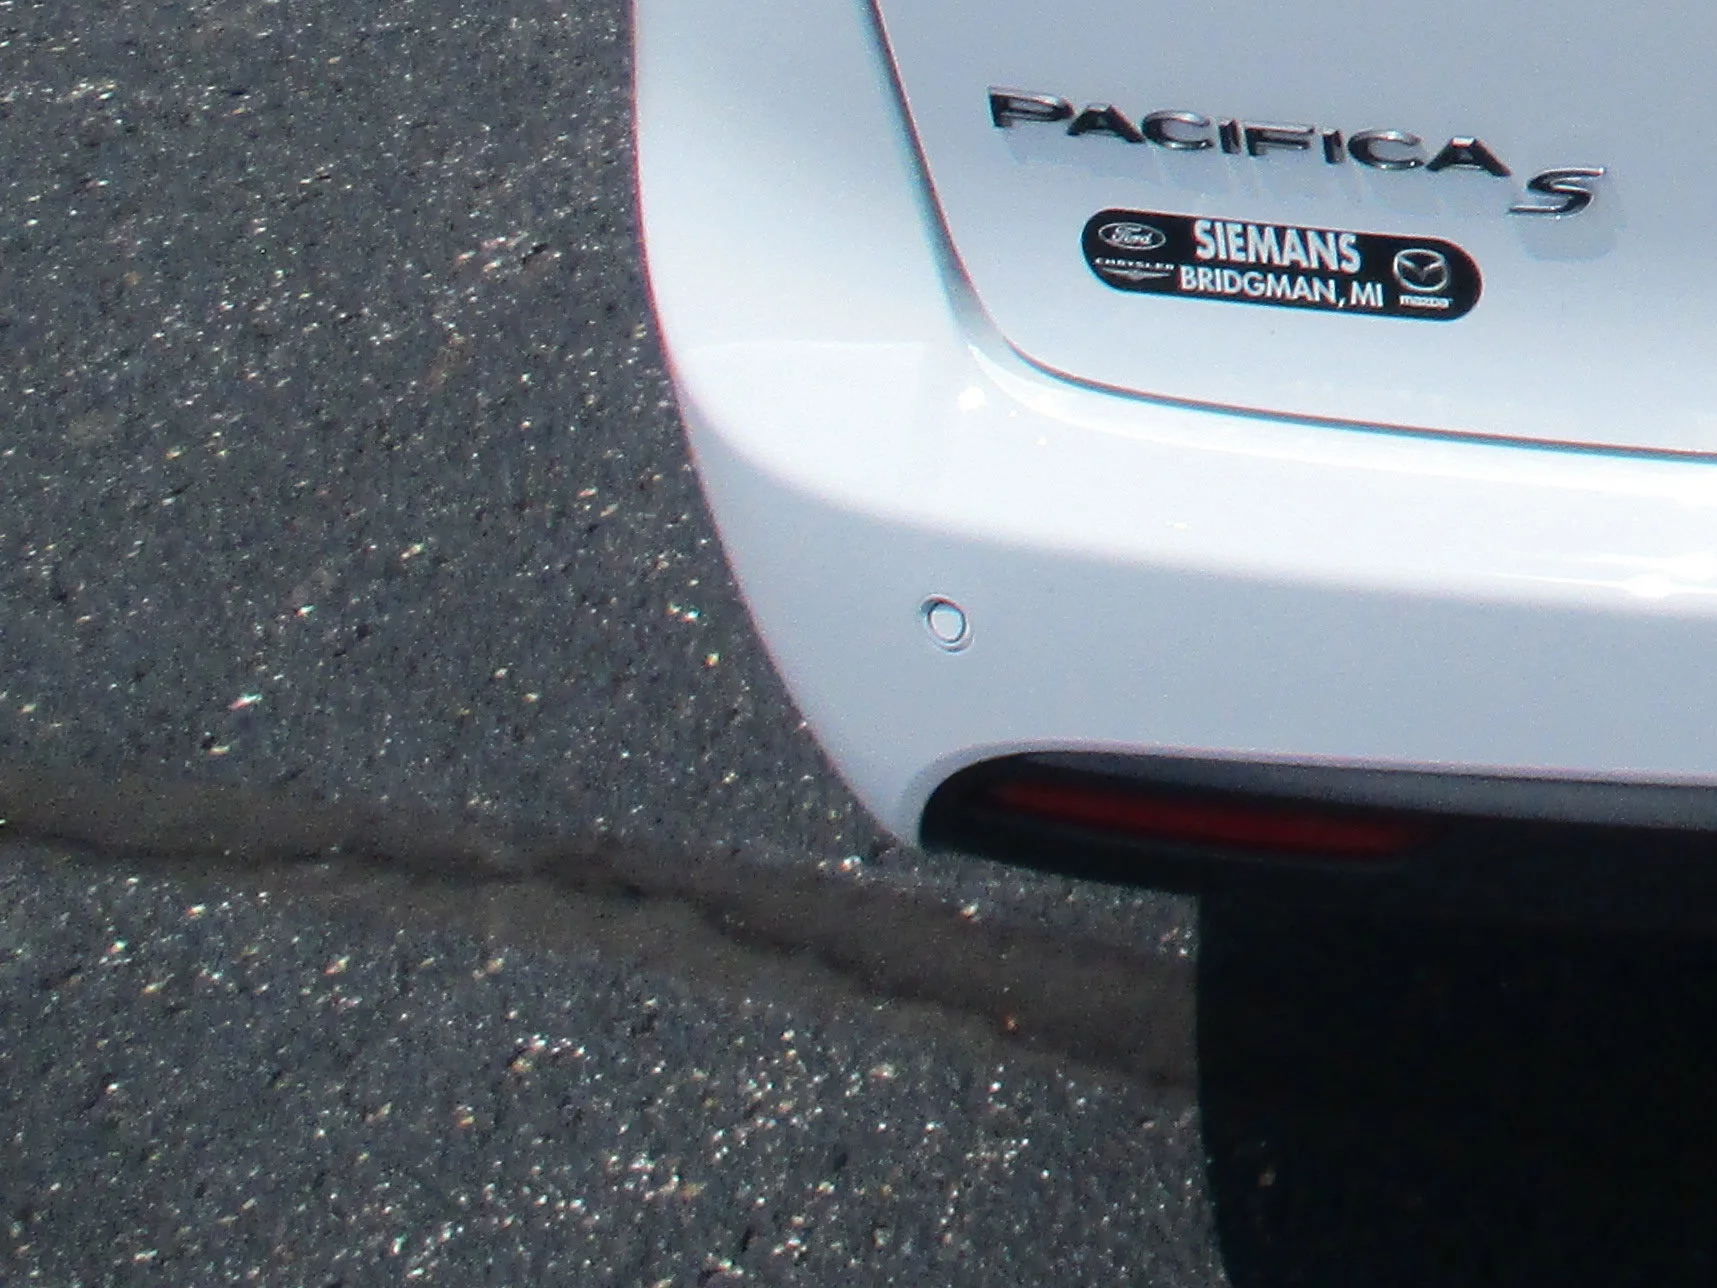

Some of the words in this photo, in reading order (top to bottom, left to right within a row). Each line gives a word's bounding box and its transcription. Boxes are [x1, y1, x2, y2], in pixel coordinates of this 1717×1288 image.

[987, 85, 1512, 176] PACIFICA
[1508, 167, 1607, 217] S
[1094, 256, 1175, 270] CHRYSLER
[1194, 219, 1361, 274] SIEMANS
[1180, 264, 1346, 308] BRIDGMAN,
[1351, 280, 1384, 308] MI
